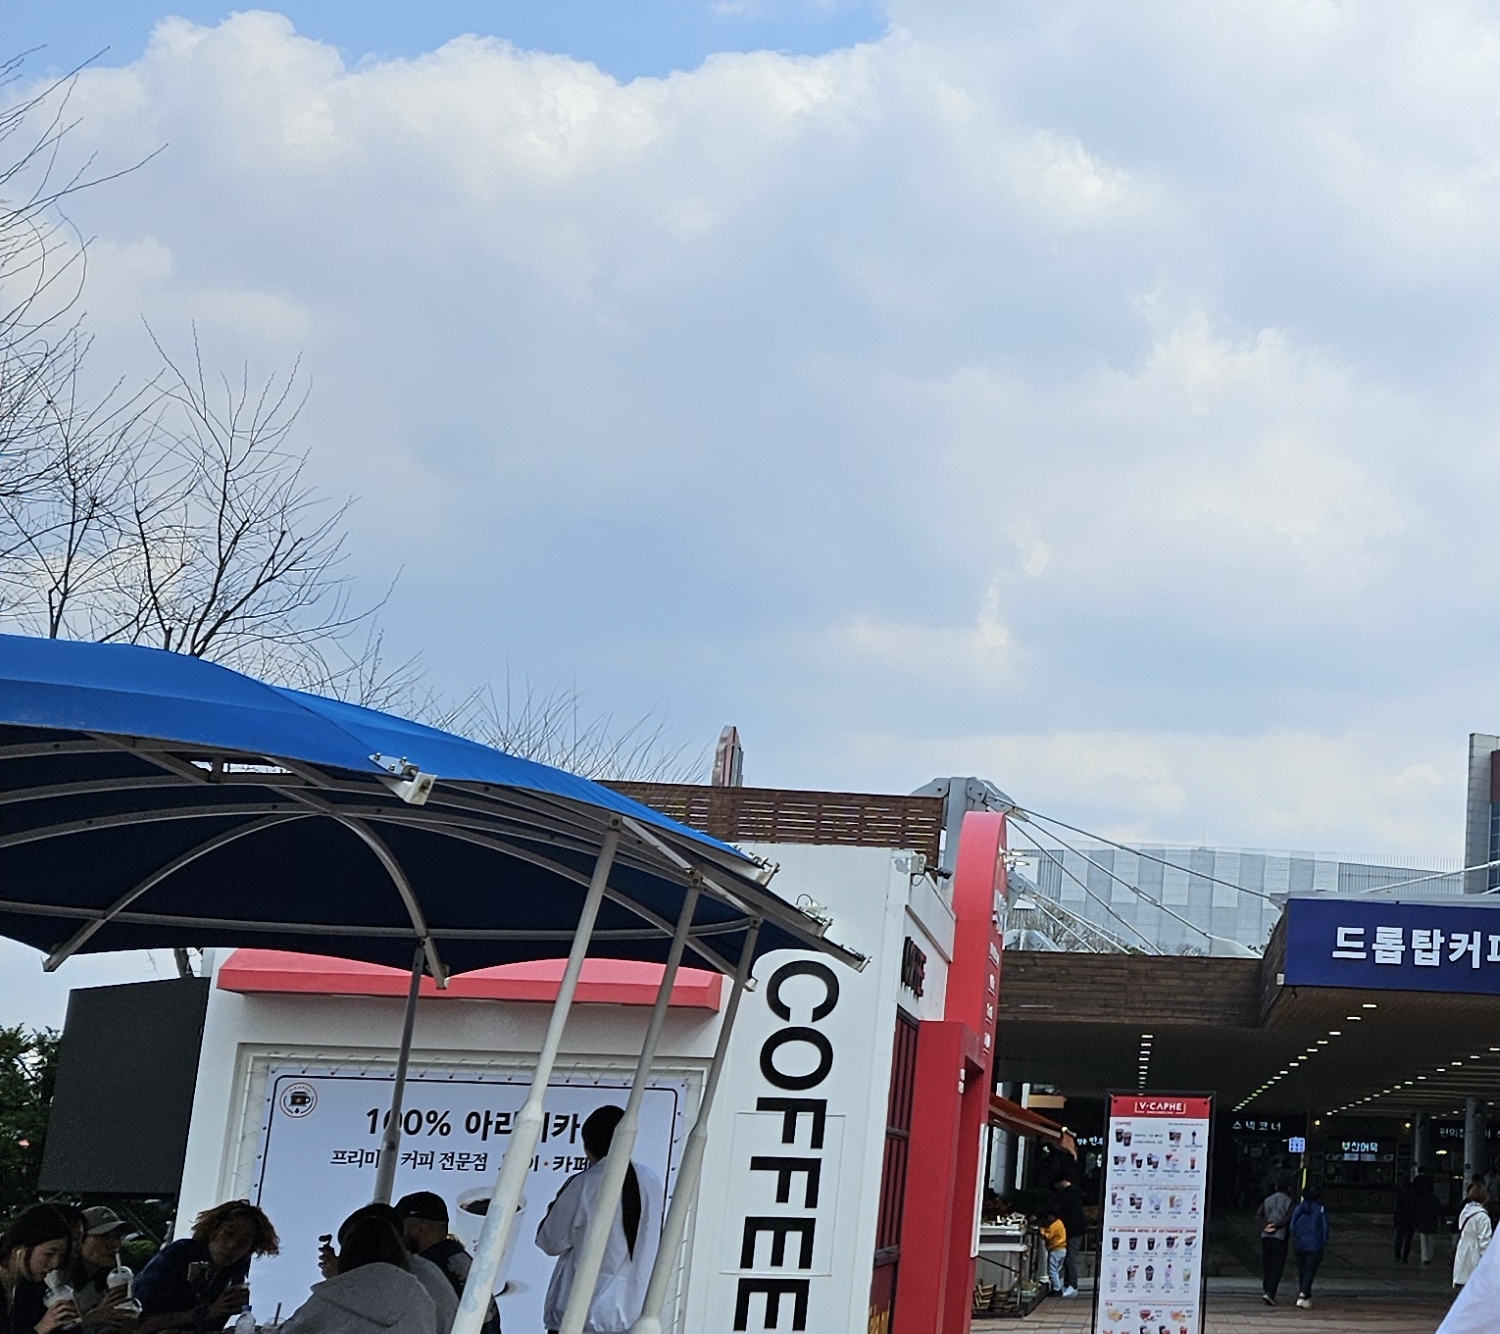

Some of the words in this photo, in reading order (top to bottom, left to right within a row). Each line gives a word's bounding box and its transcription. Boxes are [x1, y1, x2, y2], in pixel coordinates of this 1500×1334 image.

[465, 1110, 581, 1143] 아카
[330, 1149, 382, 1168] 프리미
[401, 1150, 434, 1170] 커피
[438, 1151, 487, 1171] 전문점
[733, 960, 840, 1331] COFFEE
